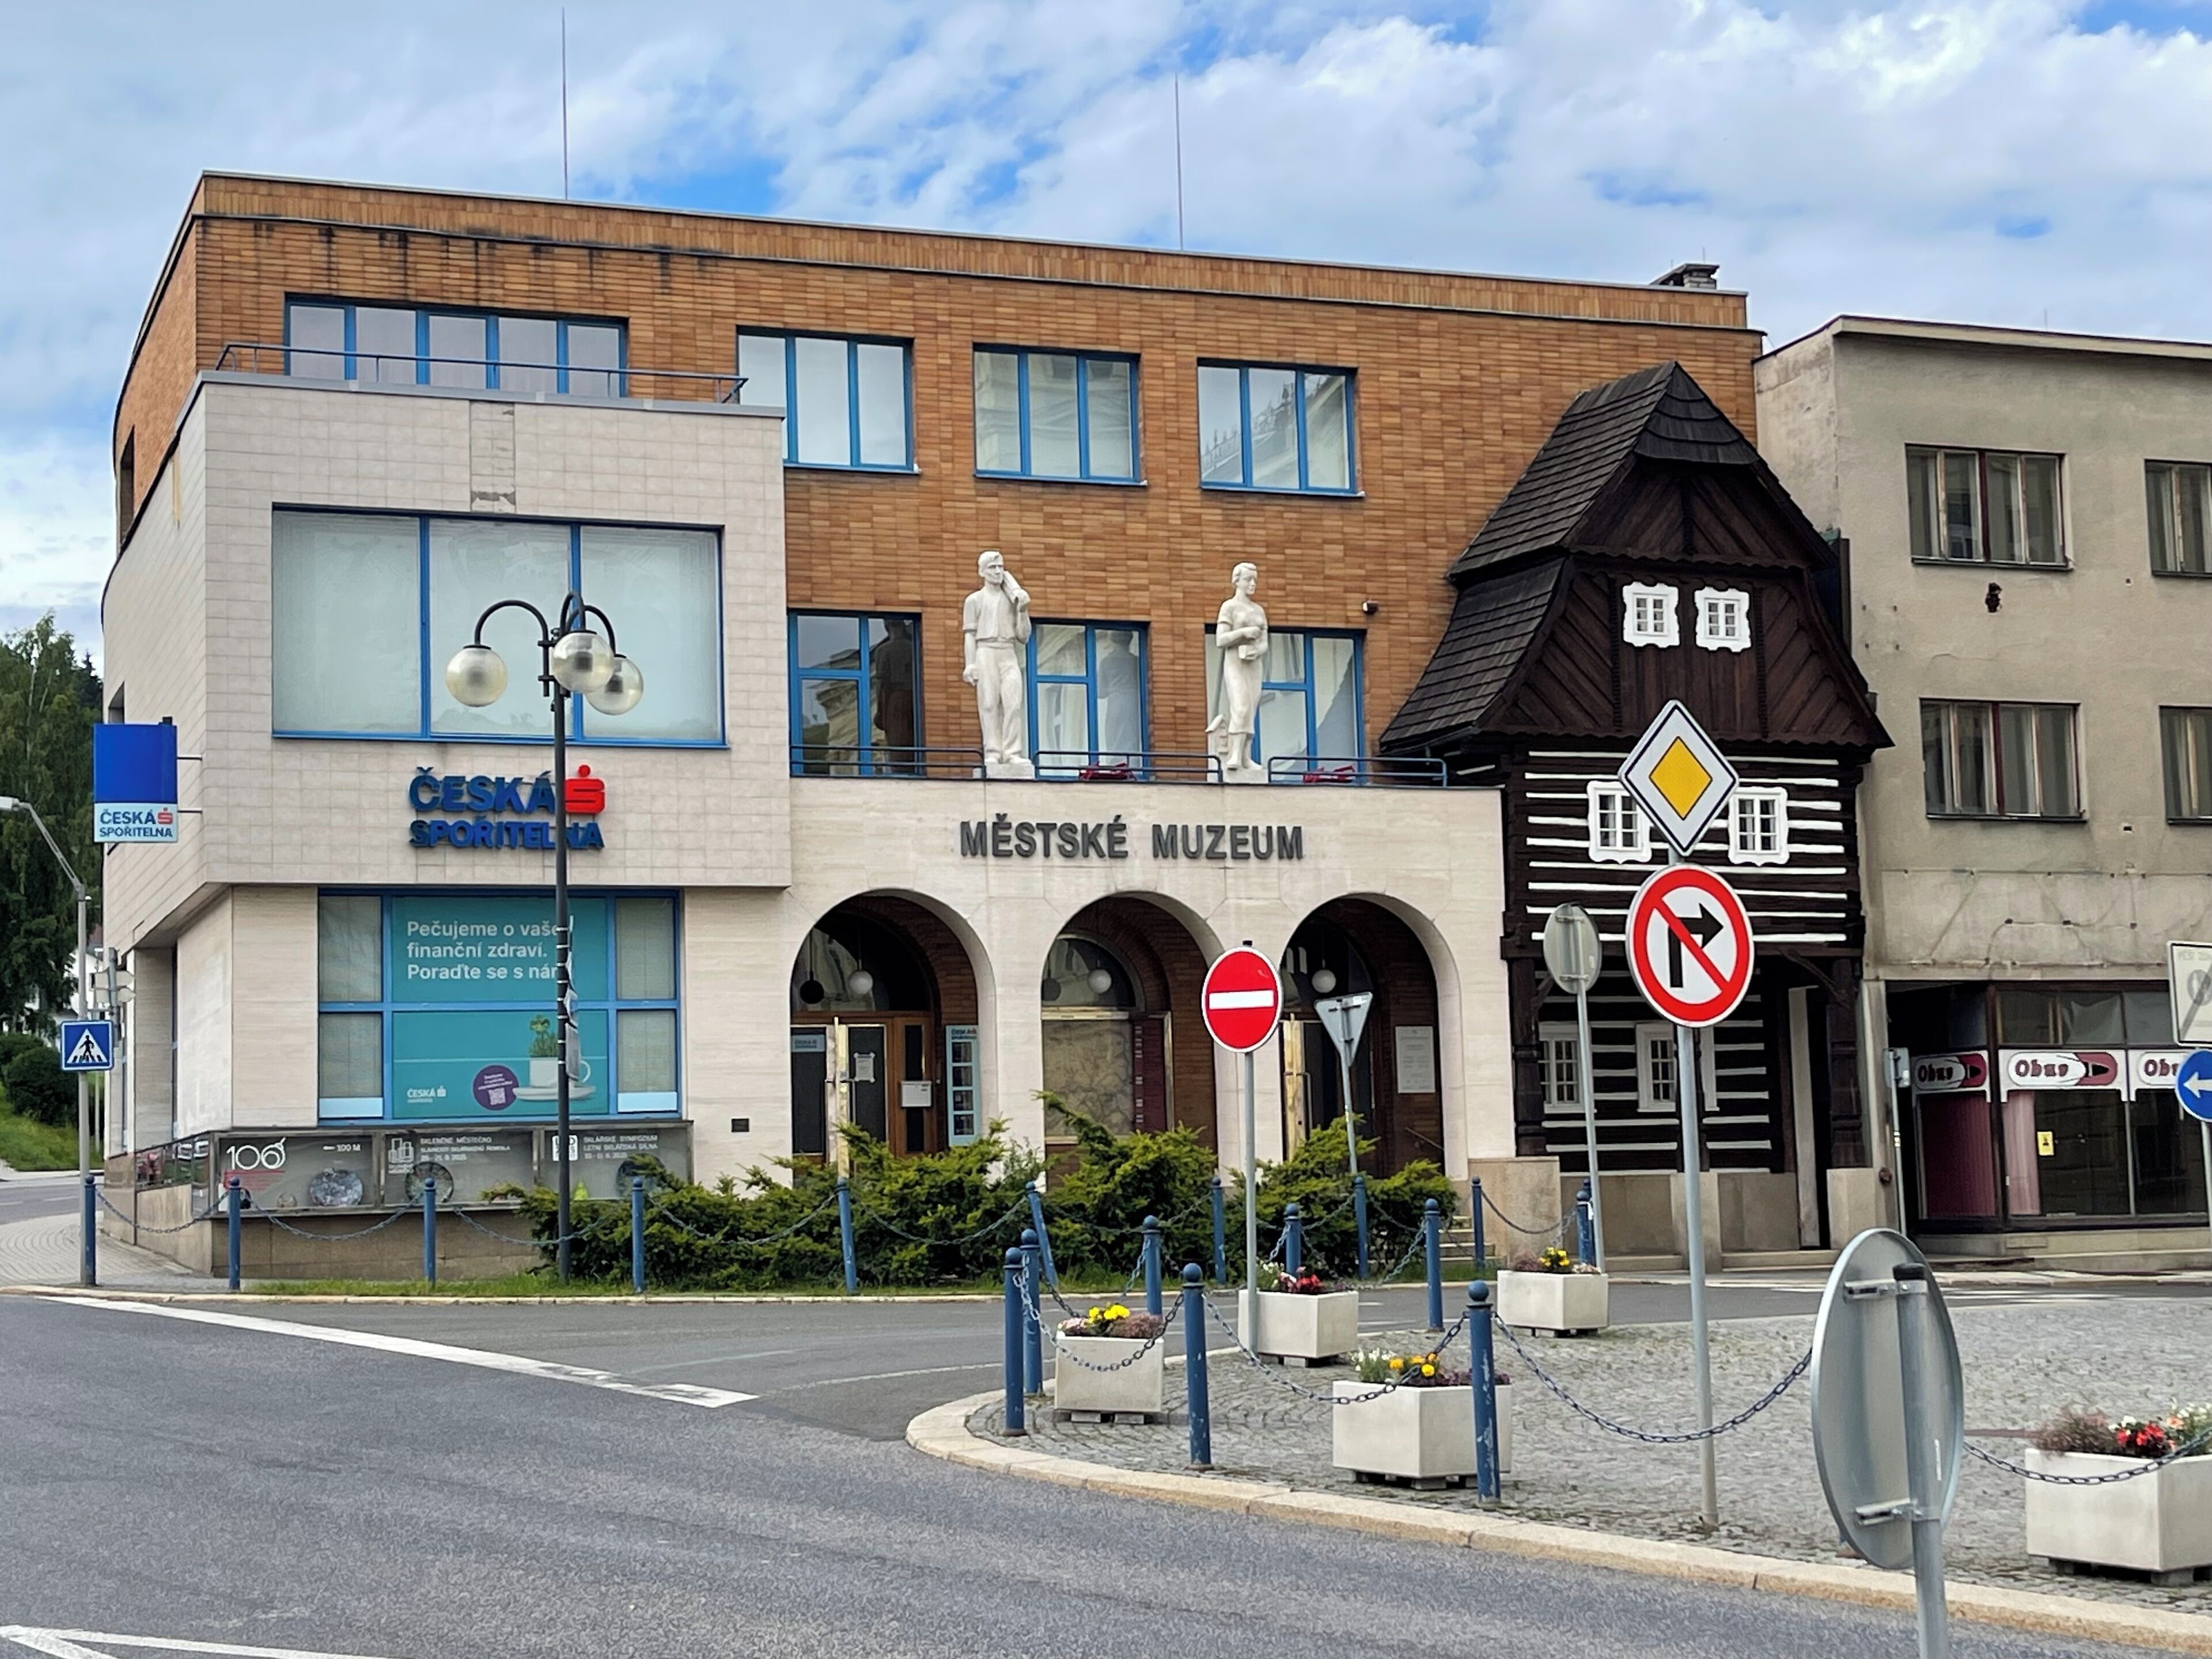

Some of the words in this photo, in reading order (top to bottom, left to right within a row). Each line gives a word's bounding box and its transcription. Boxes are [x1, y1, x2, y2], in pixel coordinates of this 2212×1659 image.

[408, 767, 555, 814] ČESKÁ
[100, 809, 156, 824] ČESKÁ
[100, 825, 173, 837] SPOŘITELNA
[960, 813, 1128, 858] MĚSTSKÉ
[1153, 824, 1303, 860] MUZEUM
[407, 921, 498, 940] Pečujeme
[503, 925, 514, 936] o
[407, 942, 482, 959] finanční
[487, 942, 547, 959] zdraví.
[407, 963, 481, 979] Poraďte
[486, 967, 507, 979] se
[513, 967, 524, 979] s
[2016, 1059, 2069, 1078] Obuv
